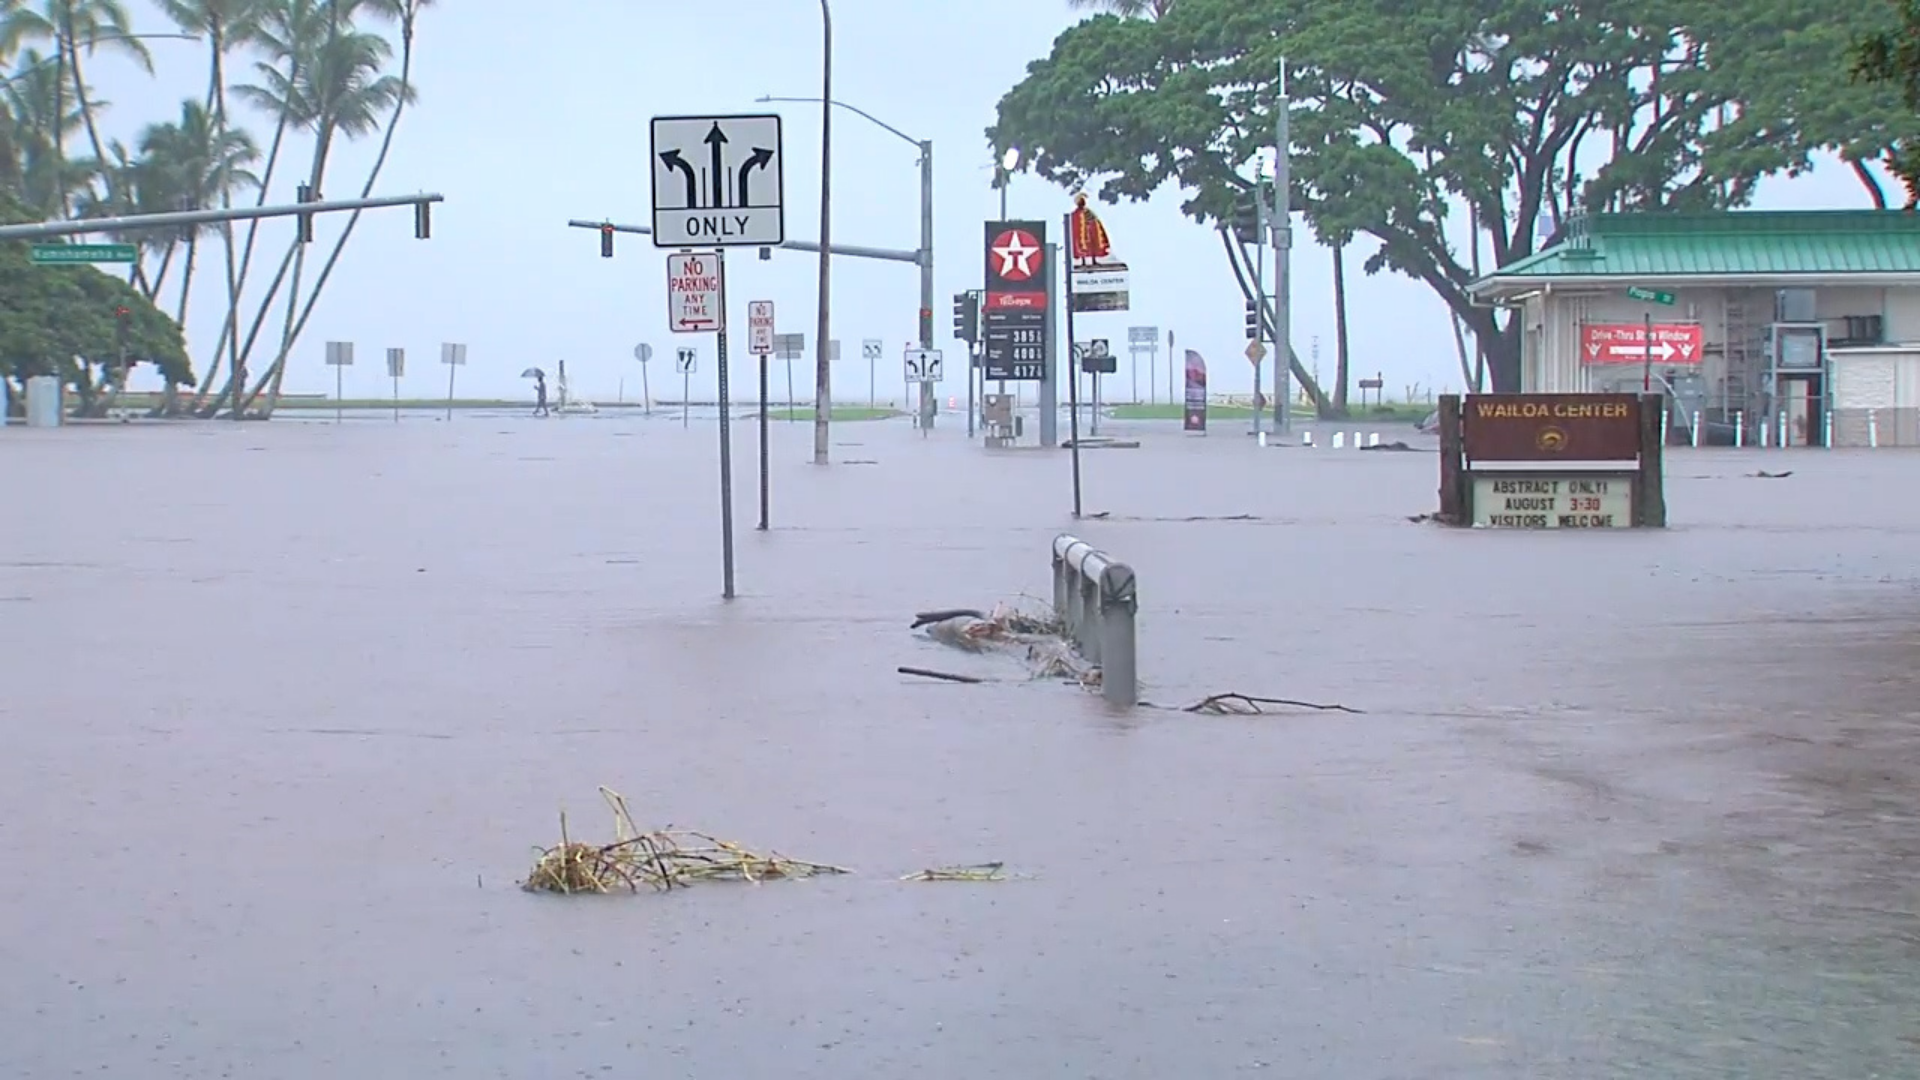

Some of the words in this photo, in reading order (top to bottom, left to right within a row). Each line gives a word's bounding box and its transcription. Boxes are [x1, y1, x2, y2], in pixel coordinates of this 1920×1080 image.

[686, 216, 750, 236] ONLY
[683, 261, 703, 275] NO
[671, 277, 717, 292] PARKING
[684, 294, 704, 303] ANY
[682, 305, 707, 316] TIME
[1478, 403, 1549, 417] WAILOA
[1554, 403, 1628, 417] CENTER
[1493, 481, 1559, 494] ABSTRACT
[1568, 481, 1608, 495] ONLY!
[1505, 498, 1555, 511] AUGUST
[1570, 498, 1600, 511] 3-30
[1490, 515, 1547, 527] VISITORS
